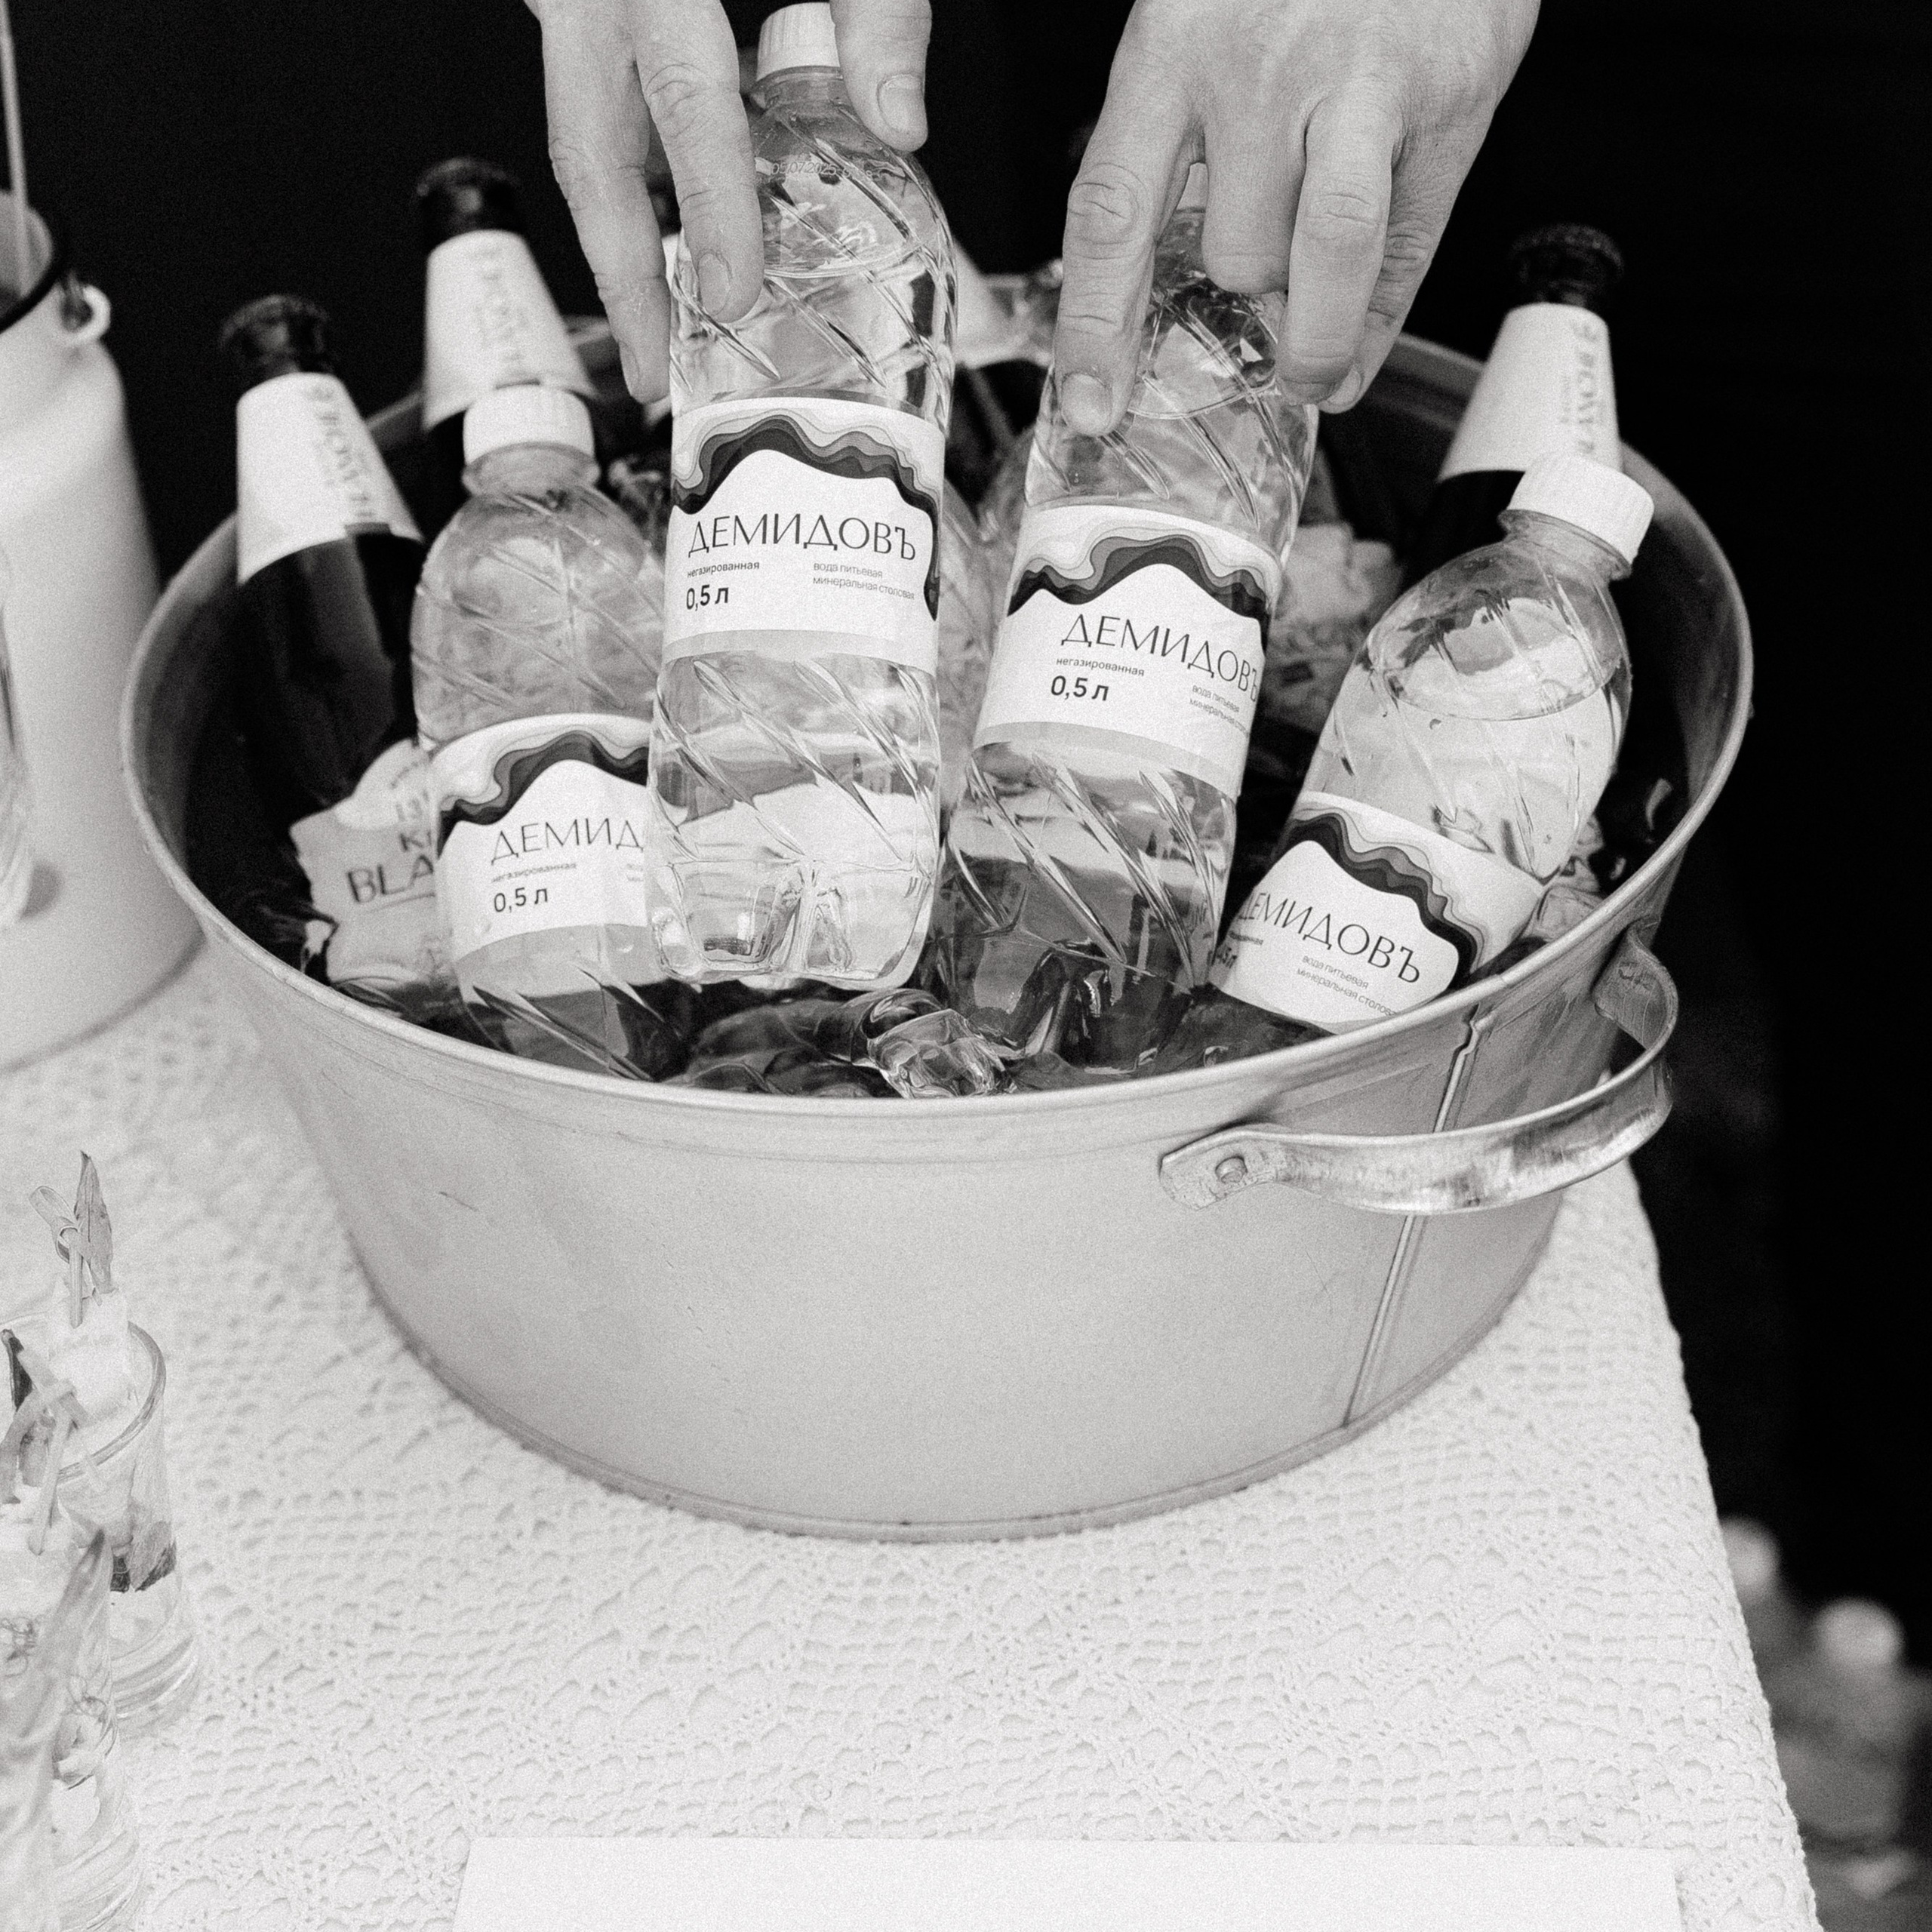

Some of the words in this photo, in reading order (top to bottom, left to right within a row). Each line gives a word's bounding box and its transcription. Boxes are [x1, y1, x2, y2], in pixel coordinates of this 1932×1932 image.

[688, 513, 916, 561] ДЕМИДОВЪ
[687, 561, 760, 579] негазированная
[814, 563, 838, 573] вода
[840, 565, 883, 579] питьевая
[686, 584, 711, 612] 0,5
[813, 577, 878, 590] минеральная
[878, 585, 915, 600] столовая
[1056, 657, 1145, 677] негазированная
[1061, 614, 1258, 703] ДЕМИДОВЪ
[1051, 675, 1088, 700] 0,5
[1192, 685, 1211, 699] вода
[491, 818, 644, 866] ДЕМИД
[346, 854, 434, 903] BLA
[494, 888, 527, 913] 0,5
[1302, 955, 1324, 970] вода
[1324, 964, 1370, 989] питьевая
[1297, 968, 1358, 1000] минеральная
[1358, 995, 1397, 1018] столова
